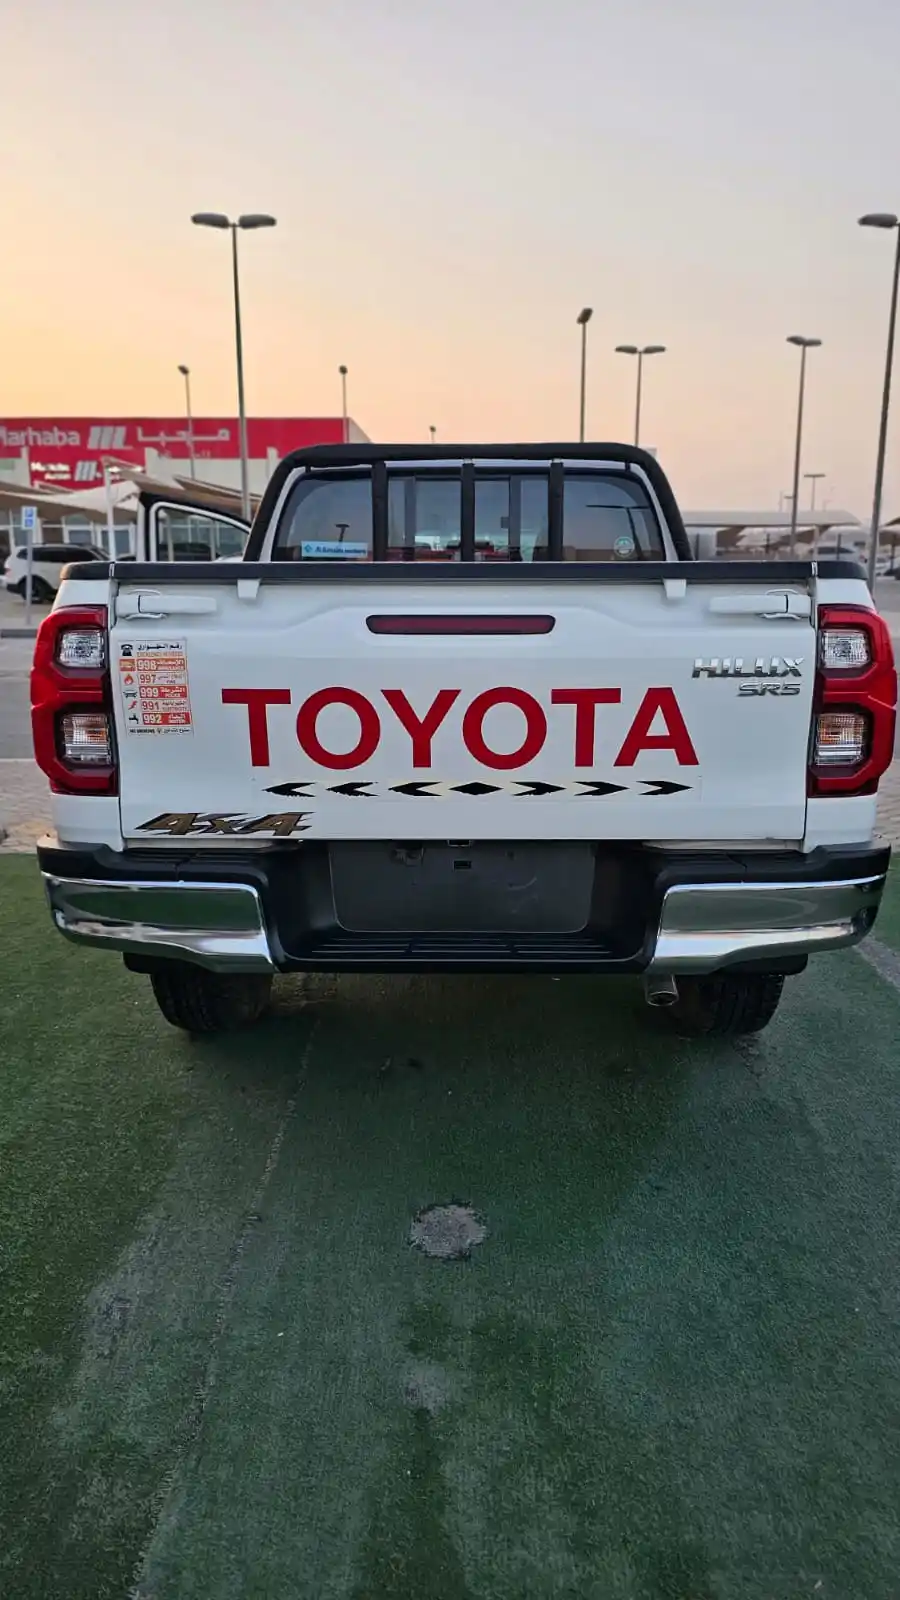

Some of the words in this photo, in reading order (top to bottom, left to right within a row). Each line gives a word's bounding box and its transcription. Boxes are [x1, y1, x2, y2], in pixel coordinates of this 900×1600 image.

[137, 659, 156, 670] 998
[692, 657, 804, 678] HILUX
[140, 674, 156, 684] 997
[140, 687, 159, 698] 999
[737, 681, 801, 697] SR5
[142, 700, 160, 710] 991
[143, 714, 162, 724] 992
[222, 687, 699, 770] TOYOTA
